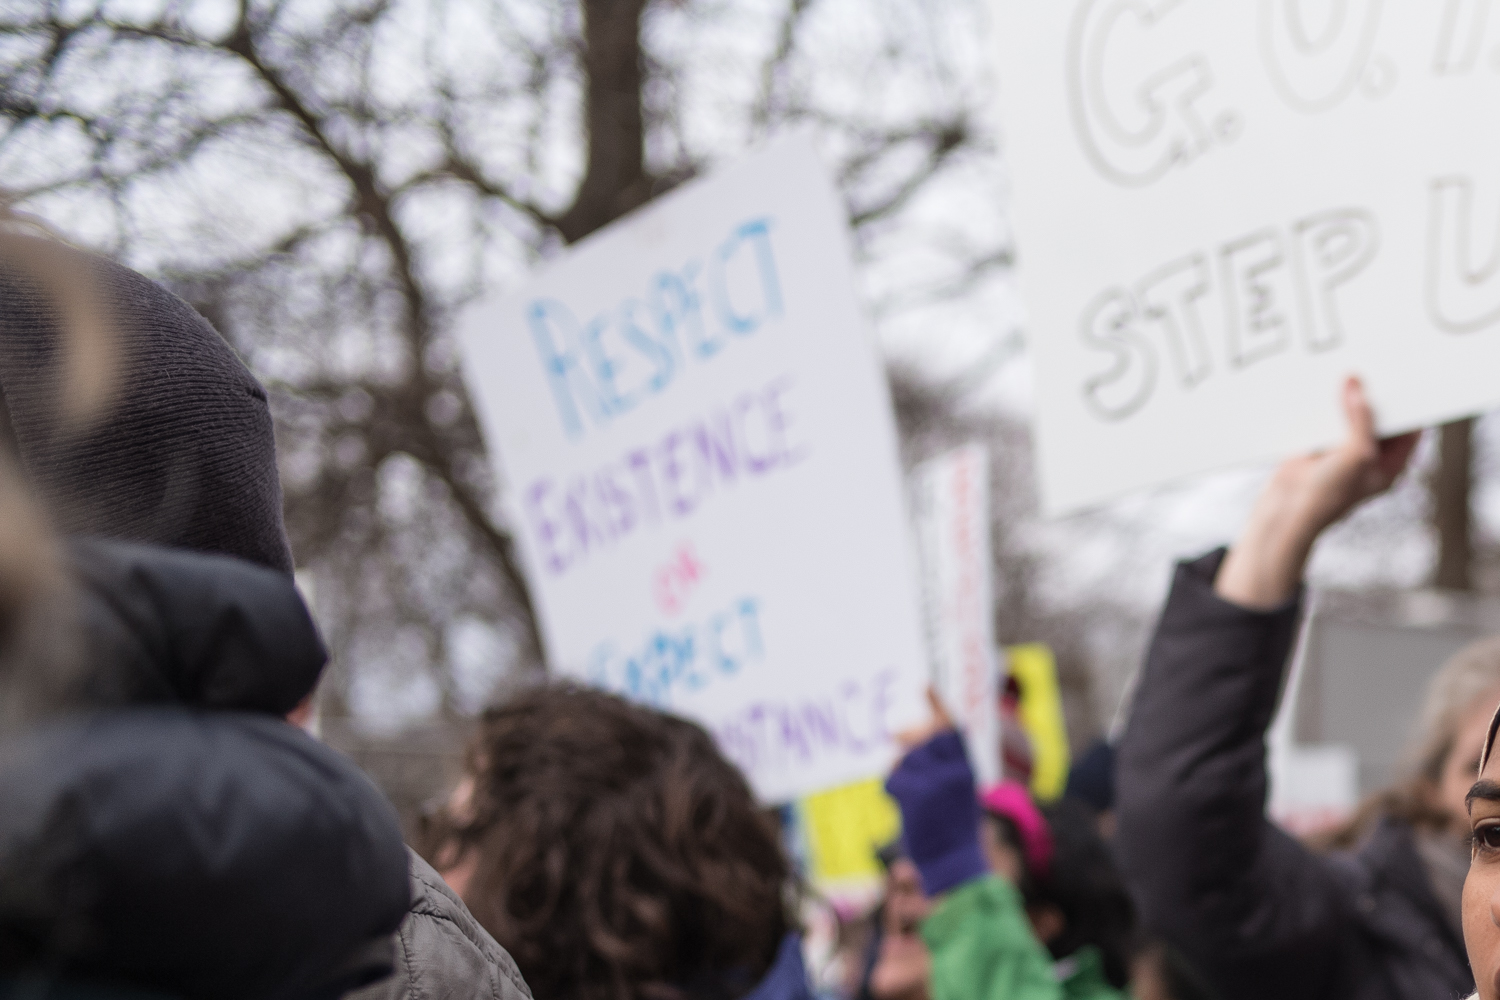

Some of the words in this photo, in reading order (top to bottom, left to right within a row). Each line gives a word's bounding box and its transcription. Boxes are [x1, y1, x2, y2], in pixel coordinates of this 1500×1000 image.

[525, 213, 785, 443] RESPECT
[1077, 205, 1380, 423] STEP
[523, 373, 811, 577] EXISTENCE
